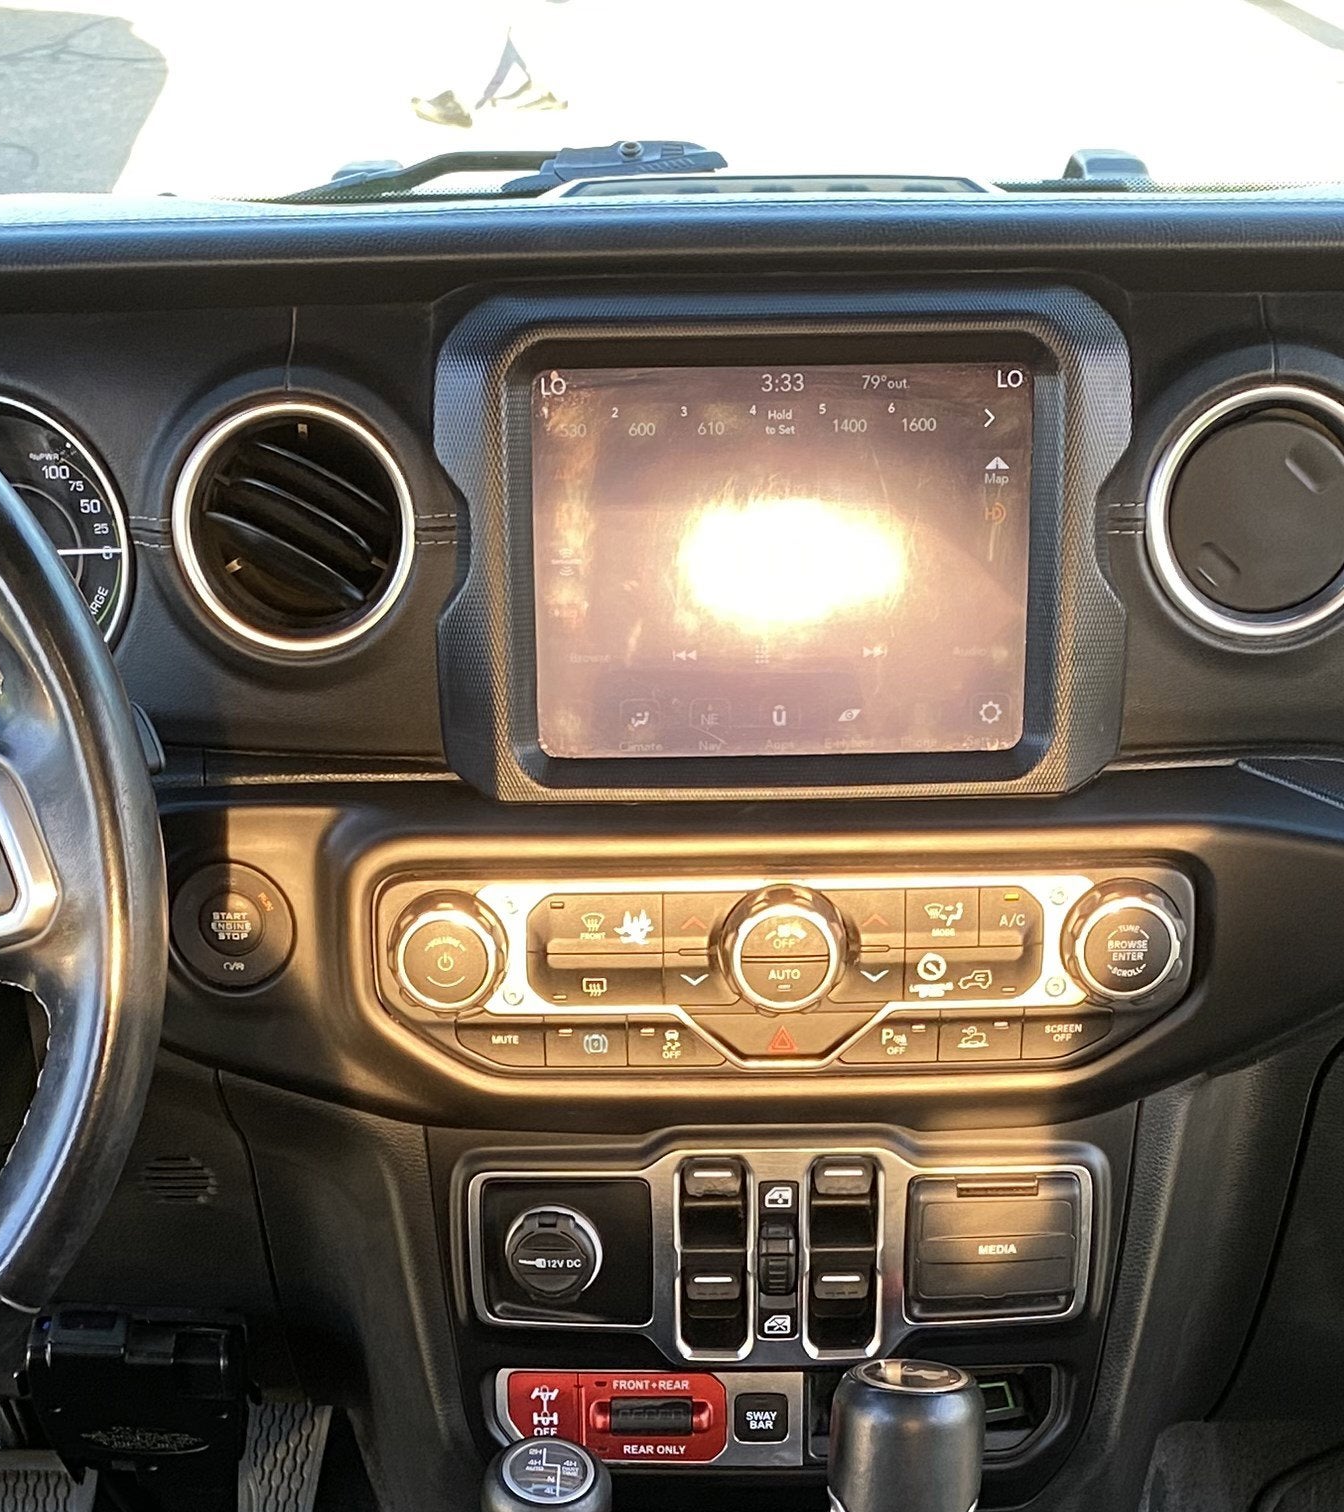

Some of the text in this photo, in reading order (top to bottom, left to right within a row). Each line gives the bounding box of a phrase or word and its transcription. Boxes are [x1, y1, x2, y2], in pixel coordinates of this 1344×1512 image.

[761, 373, 805, 393] 3:33
[997, 369, 1024, 388] LO
[540, 377, 567, 395] LO
[611, 407, 619, 418] 2
[680, 405, 688, 417] 3
[749, 404, 757, 416] 4
[818, 403, 827, 415] 5
[887, 403, 895, 414] 6
[767, 409, 793, 421] Hold
[628, 422, 656, 437] 600
[697, 421, 725, 436] 610
[765, 424, 795, 436] to Set
[833, 418, 867, 433] 1400
[902, 417, 937, 433] 1600
[41, 465, 70, 480] 100
[984, 474, 1009, 486] Map
[68, 480, 85, 493] 75
[80, 499, 101, 514] 50
[93, 522, 110, 535] 25
[700, 713, 720, 726] NE
[212, 912, 248, 920] START
[999, 913, 1026, 928] A/C
[211, 921, 252, 931] ENGINE
[1118, 923, 1141, 934] TUNE
[218, 932, 249, 940] STOP
[773, 937, 796, 950] OFF
[1107, 938, 1149, 950] BROWSE
[1112, 951, 1144, 962] ENTER
[768, 968, 801, 981] AUTO
[1045, 1023, 1083, 1035] SCREEN
[491, 1033, 519, 1045] MUTE
[1052, 1032, 1072, 1042] OFF
[662, 1050, 681, 1060] OFF
[886, 1046, 906, 1056] OFF
[978, 1243, 1018, 1255] MEDIA
[547, 1258, 582, 1269] 12V DC
[612, 1379, 690, 1390] FRONT REAR
[746, 1411, 778, 1421] SWAY
[749, 1420, 774, 1430] BAR
[533, 1427, 558, 1436] OFF
[623, 1444, 686, 1455] REAR ONLY
